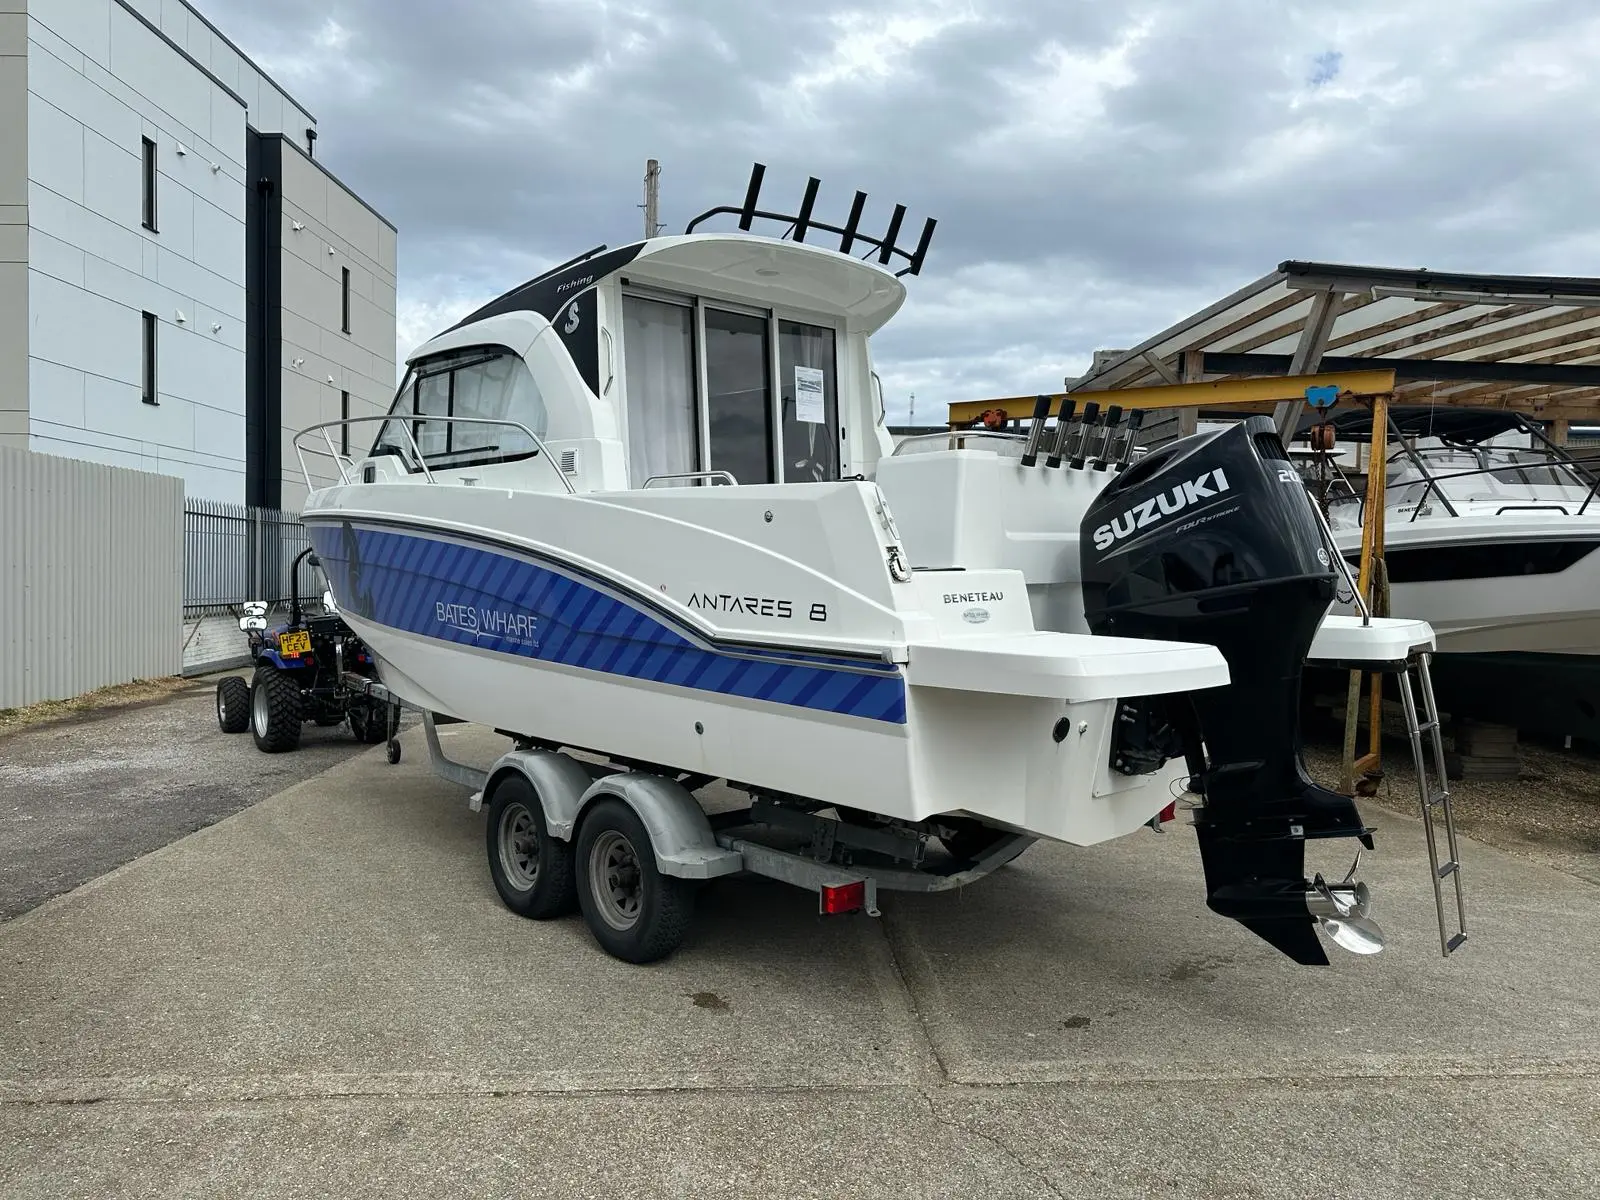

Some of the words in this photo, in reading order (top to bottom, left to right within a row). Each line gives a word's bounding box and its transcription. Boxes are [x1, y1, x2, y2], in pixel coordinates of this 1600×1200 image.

[557, 275, 594, 293] Fishing
[1093, 468, 1230, 551] SUZUKI
[943, 591, 1004, 604] BENETEAU
[687, 592, 793, 619] ANTARES
[809, 603, 827, 622] 8
[436, 602, 477, 628] BATES
[481, 608, 538, 638] WHARF
[282, 633, 308, 644] HF23
[287, 642, 306, 652] CEV
